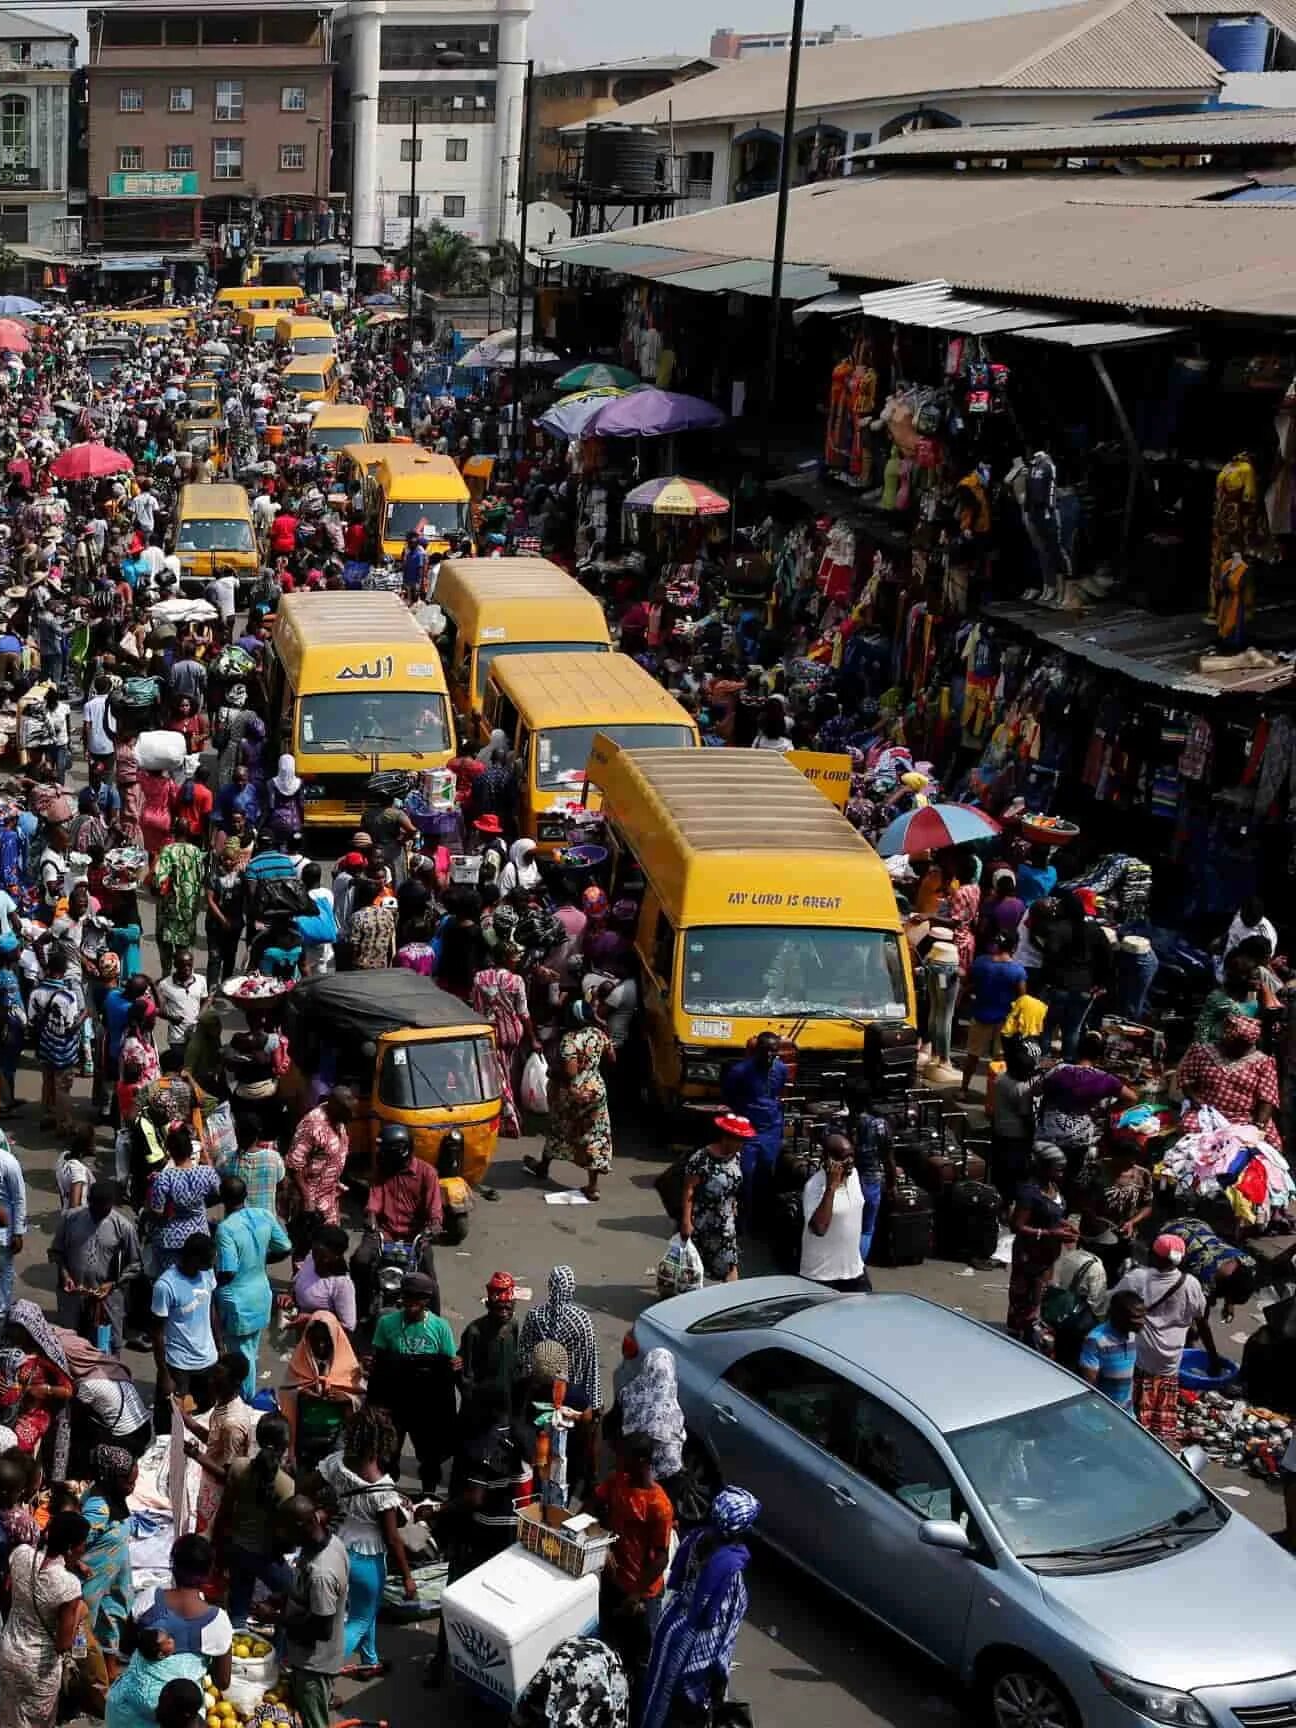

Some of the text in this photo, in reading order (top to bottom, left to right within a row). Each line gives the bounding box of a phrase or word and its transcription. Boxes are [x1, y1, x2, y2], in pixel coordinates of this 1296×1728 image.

[728, 892, 842, 910] MY LORD IS GREAT
